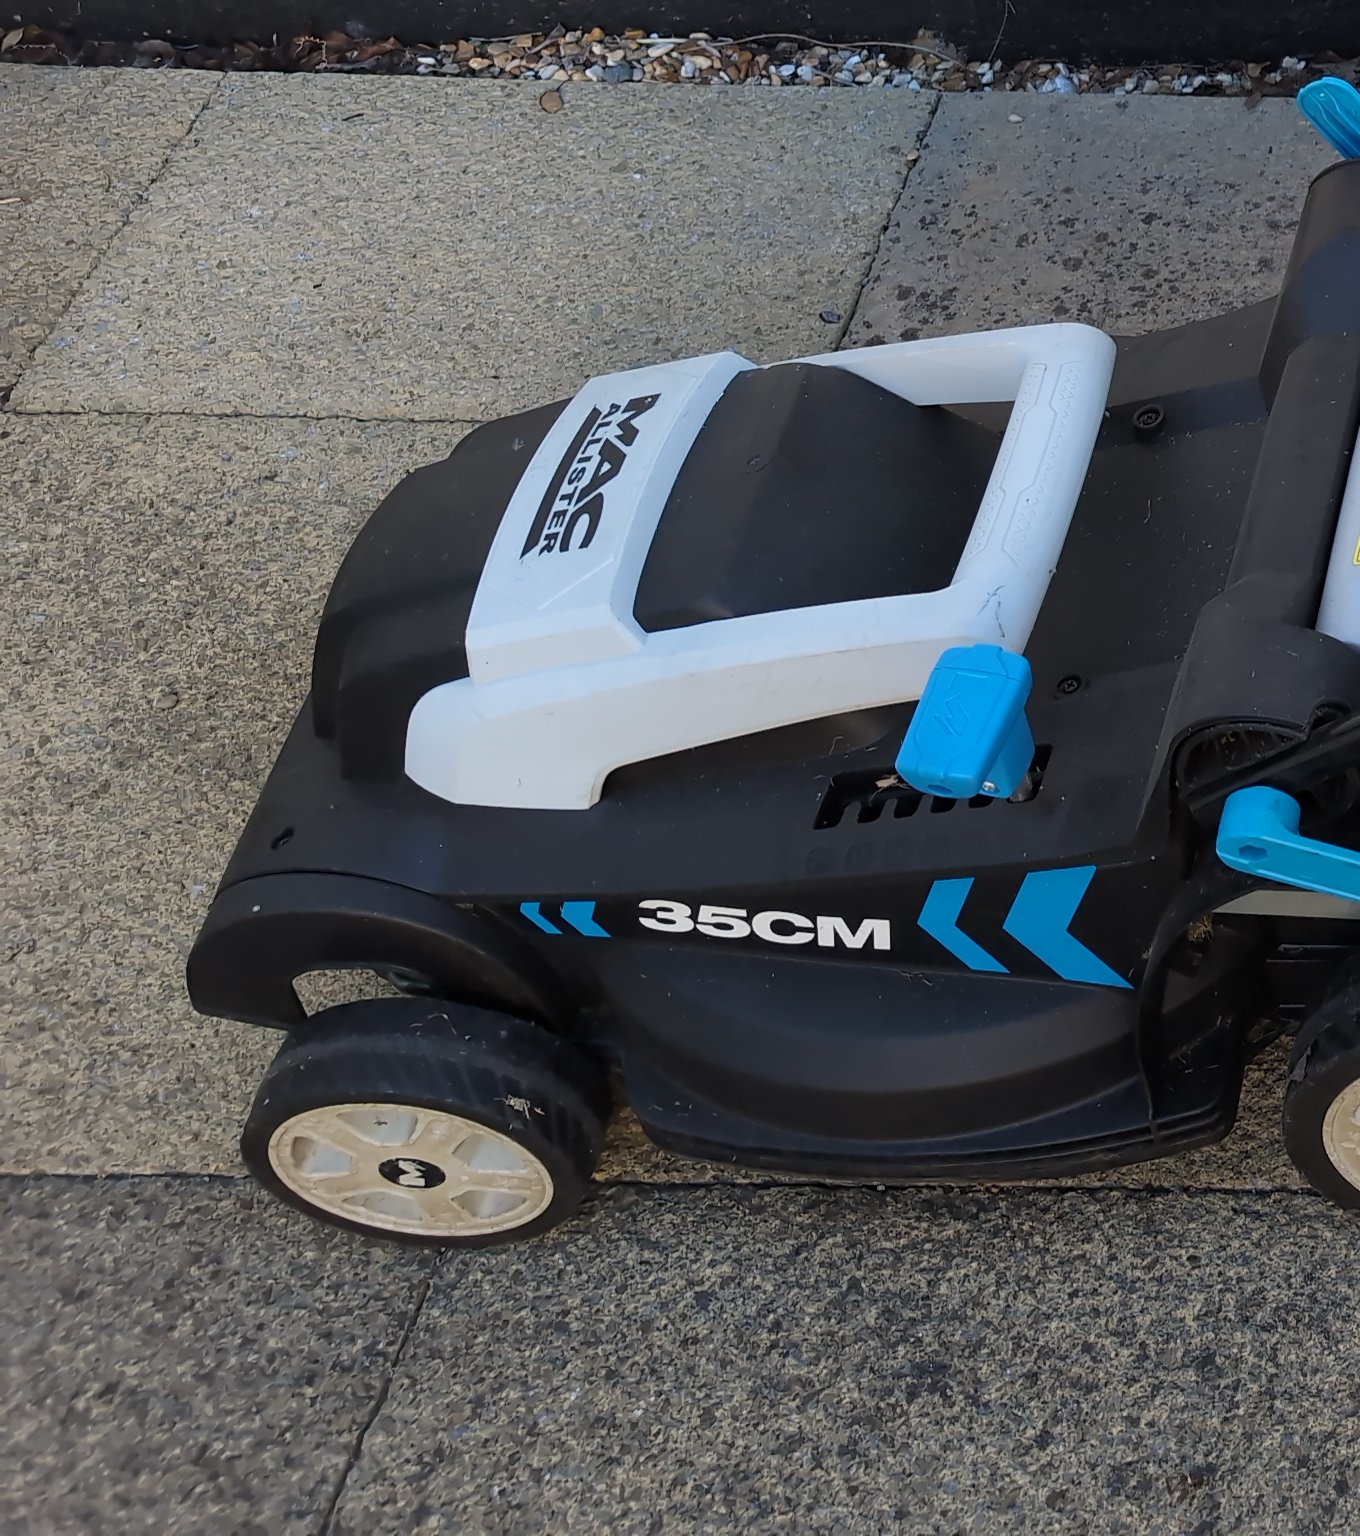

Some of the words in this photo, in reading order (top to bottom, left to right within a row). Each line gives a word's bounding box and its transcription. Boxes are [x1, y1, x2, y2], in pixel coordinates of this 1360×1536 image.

[538, 402, 622, 557] ALLISTER
[559, 393, 661, 553] MAC
[637, 899, 892, 951] 35CM
